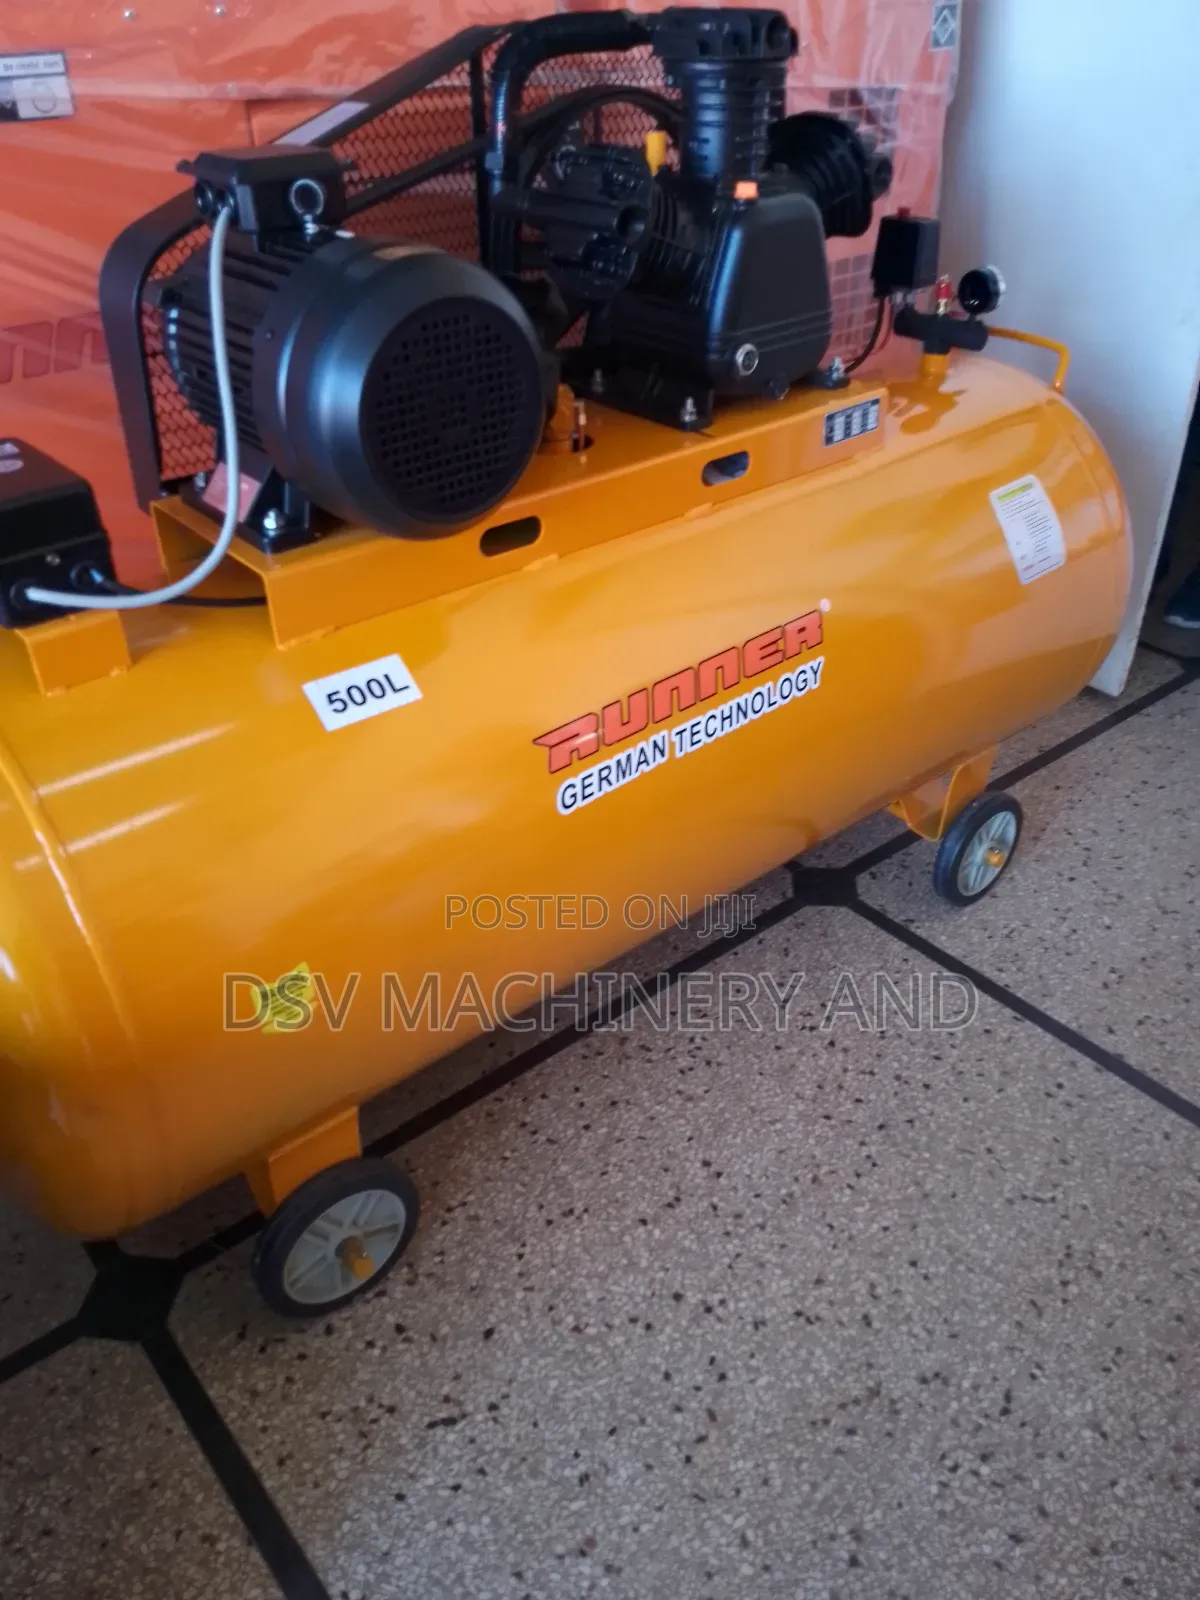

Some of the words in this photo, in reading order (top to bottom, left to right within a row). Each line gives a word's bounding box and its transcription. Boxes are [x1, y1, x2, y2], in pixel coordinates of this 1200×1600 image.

[327, 673, 410, 714] 500L
[532, 609, 823, 774] RUNNER
[560, 734, 667, 811] GERMAN
[674, 660, 822, 754] TECHNOLOGY
